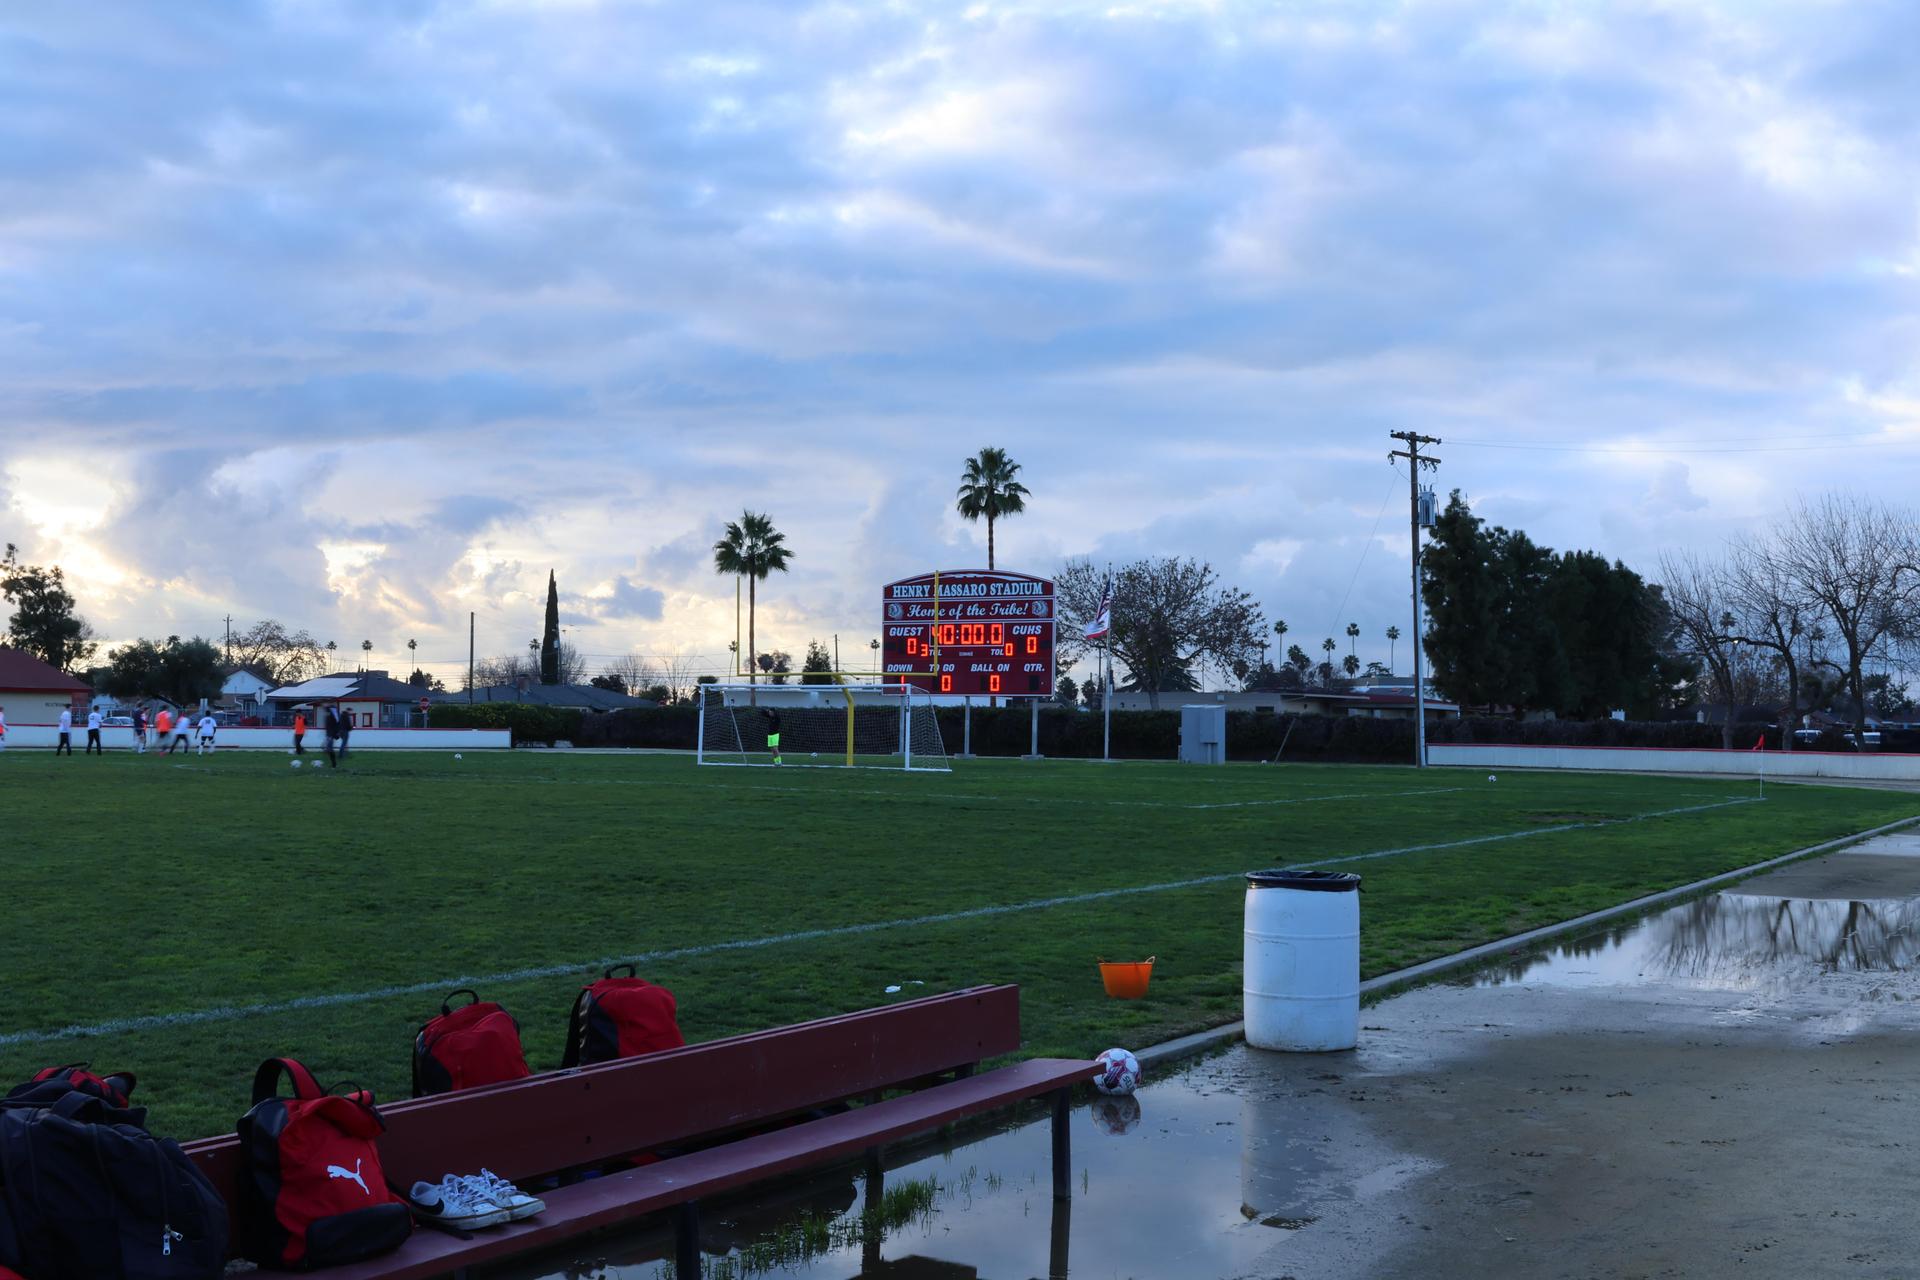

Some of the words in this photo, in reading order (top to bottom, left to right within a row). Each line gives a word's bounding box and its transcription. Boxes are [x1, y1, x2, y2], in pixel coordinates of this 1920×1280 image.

[893, 585, 931, 598] HENRY
[933, 583, 987, 597] MASSARO
[990, 582, 1043, 596] STADIUM
[907, 604, 945, 617] Home
[949, 603, 963, 620] of
[966, 603, 986, 616] the
[989, 602, 1029, 616] Tribe!
[889, 626, 924, 637] GUEST
[1012, 625, 1042, 635] CUHS
[907, 638, 917, 655] 0
[921, 643, 928, 657] 3
[1005, 642, 1014, 656] 0
[1026, 636, 1037, 654] 0
[929, 648, 943, 657] TL
[990, 648, 1004, 656] TOL
[887, 663, 913, 672] DOWN
[943, 663, 955, 672] GO
[971, 663, 993, 672] BALL
[997, 663, 1010, 672] ON
[1023, 663, 1045, 672] QTR.
[941, 674, 951, 692] 0
[990, 674, 1000, 692] 0
